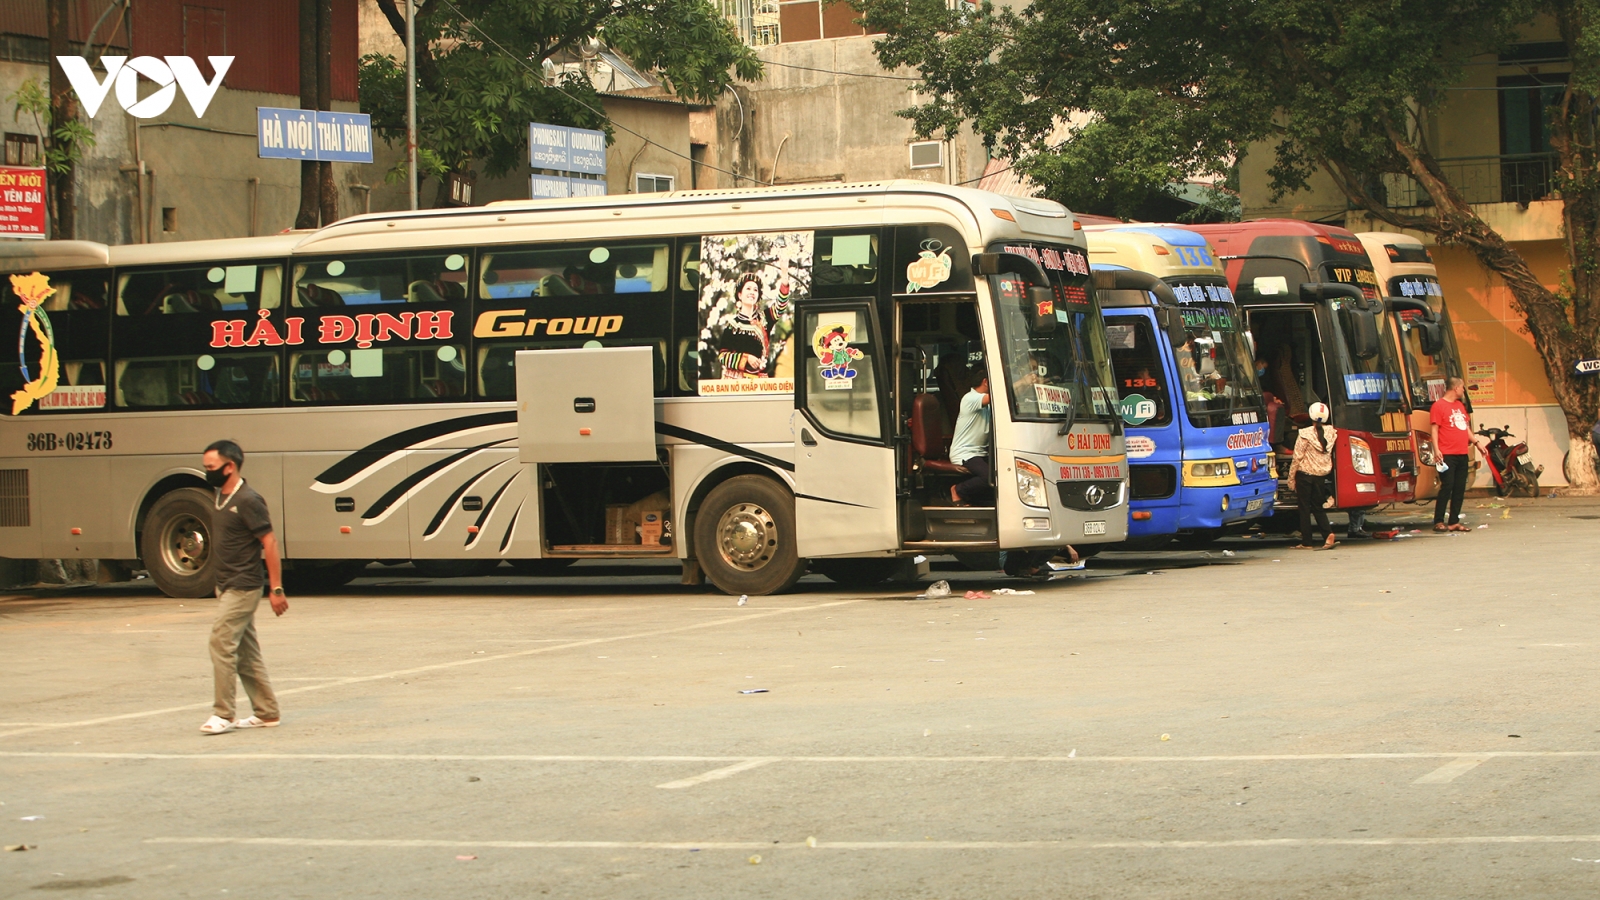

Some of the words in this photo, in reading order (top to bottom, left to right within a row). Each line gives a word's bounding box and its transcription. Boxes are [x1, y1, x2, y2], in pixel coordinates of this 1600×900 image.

[262, 113, 283, 148] HÀ
[287, 114, 313, 156] NỘI
[317, 117, 342, 151] THÁI
[343, 118, 369, 153] BÌNH
[533, 127, 567, 148] PHONGSALY
[571, 132, 604, 152] OUDOMXAY
[3, 188, 23, 203] YÊN
[1174, 247, 1213, 266] 136
[1333, 268, 1352, 282] VIP
[209, 308, 305, 348] HẢI
[318, 310, 454, 349] ĐỊNH
[473, 308, 624, 338] Group
[1582, 361, 1600, 370] WC
[701, 384, 715, 393] HOA
[716, 384, 729, 392] BAN
[730, 381, 740, 392] NỞ
[759, 381, 778, 391] VÙNG
[779, 380, 794, 393] ĐIỆN
[1124, 378, 1157, 388] 136
[1077, 427, 1091, 450] HẢI
[1092, 433, 1111, 454] ĐỊNH
